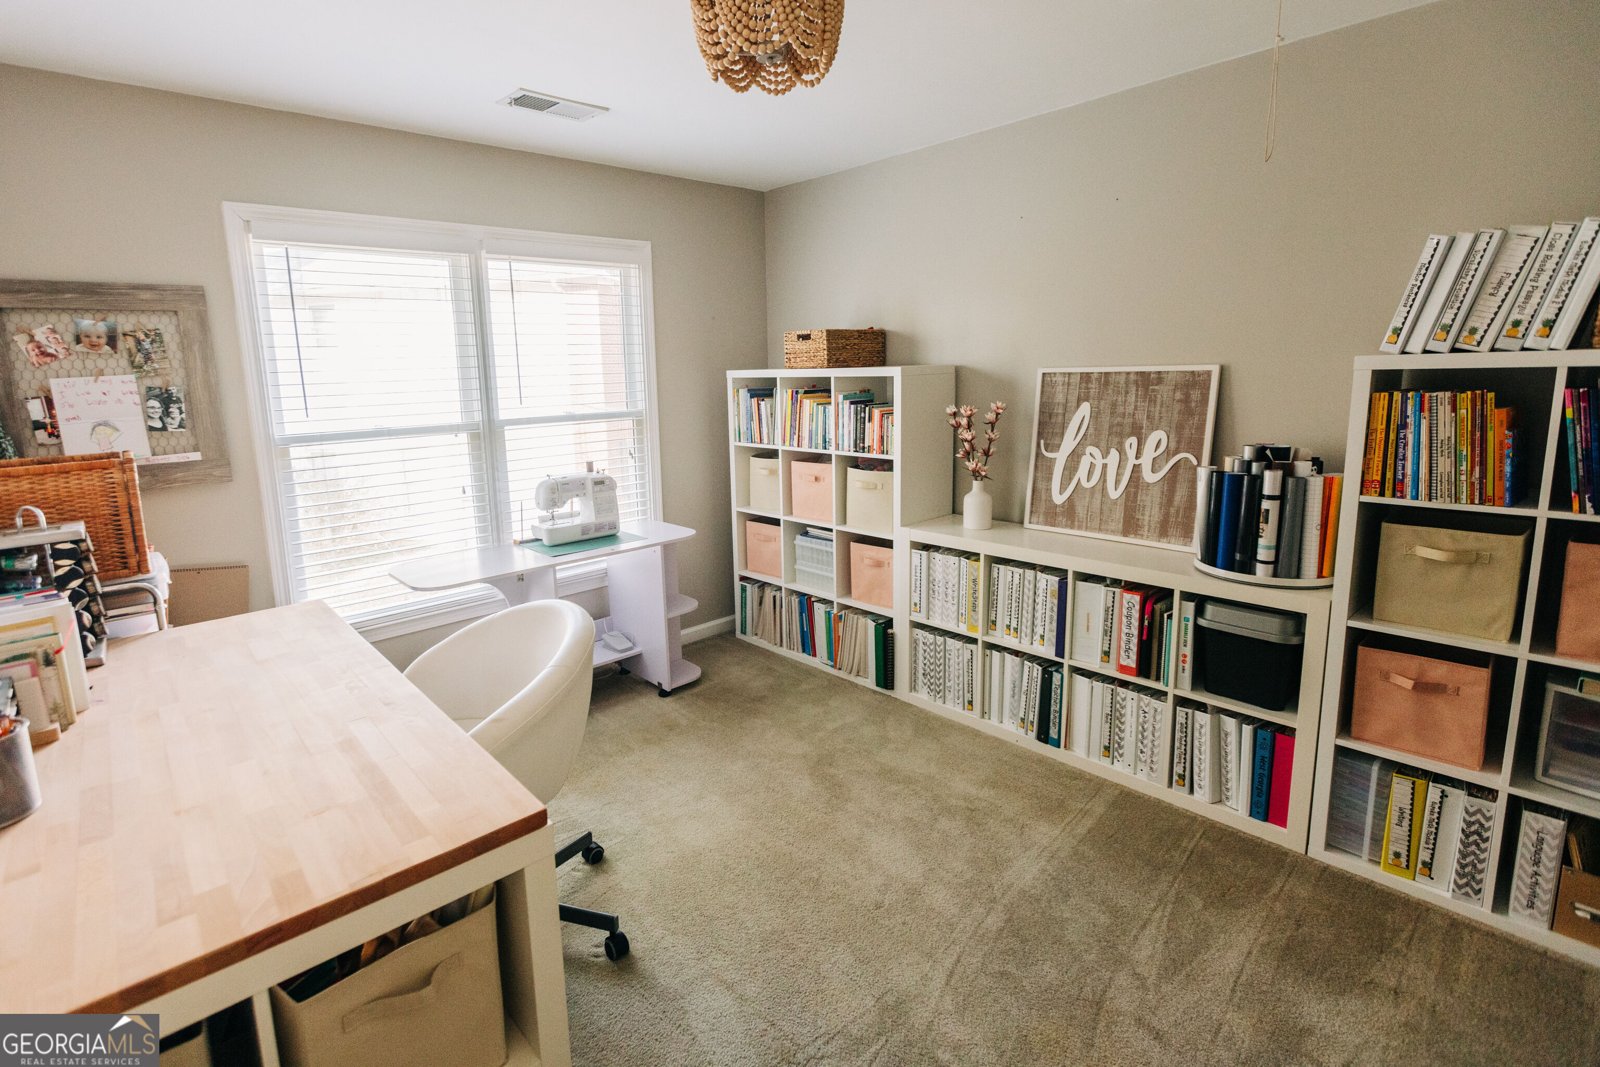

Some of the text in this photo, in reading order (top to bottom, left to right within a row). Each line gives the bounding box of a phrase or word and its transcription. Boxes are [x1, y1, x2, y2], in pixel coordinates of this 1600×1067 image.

[1489, 271, 1512, 297] Fluency
[1530, 254, 1554, 284] Reading
[1040, 401, 1198, 505] love
[1124, 600, 1136, 659] Coupon Binder
[1256, 755, 1269, 799] West Georgia
[1395, 806, 1407, 828] Writing
[1526, 829, 1548, 911] Language Activities
